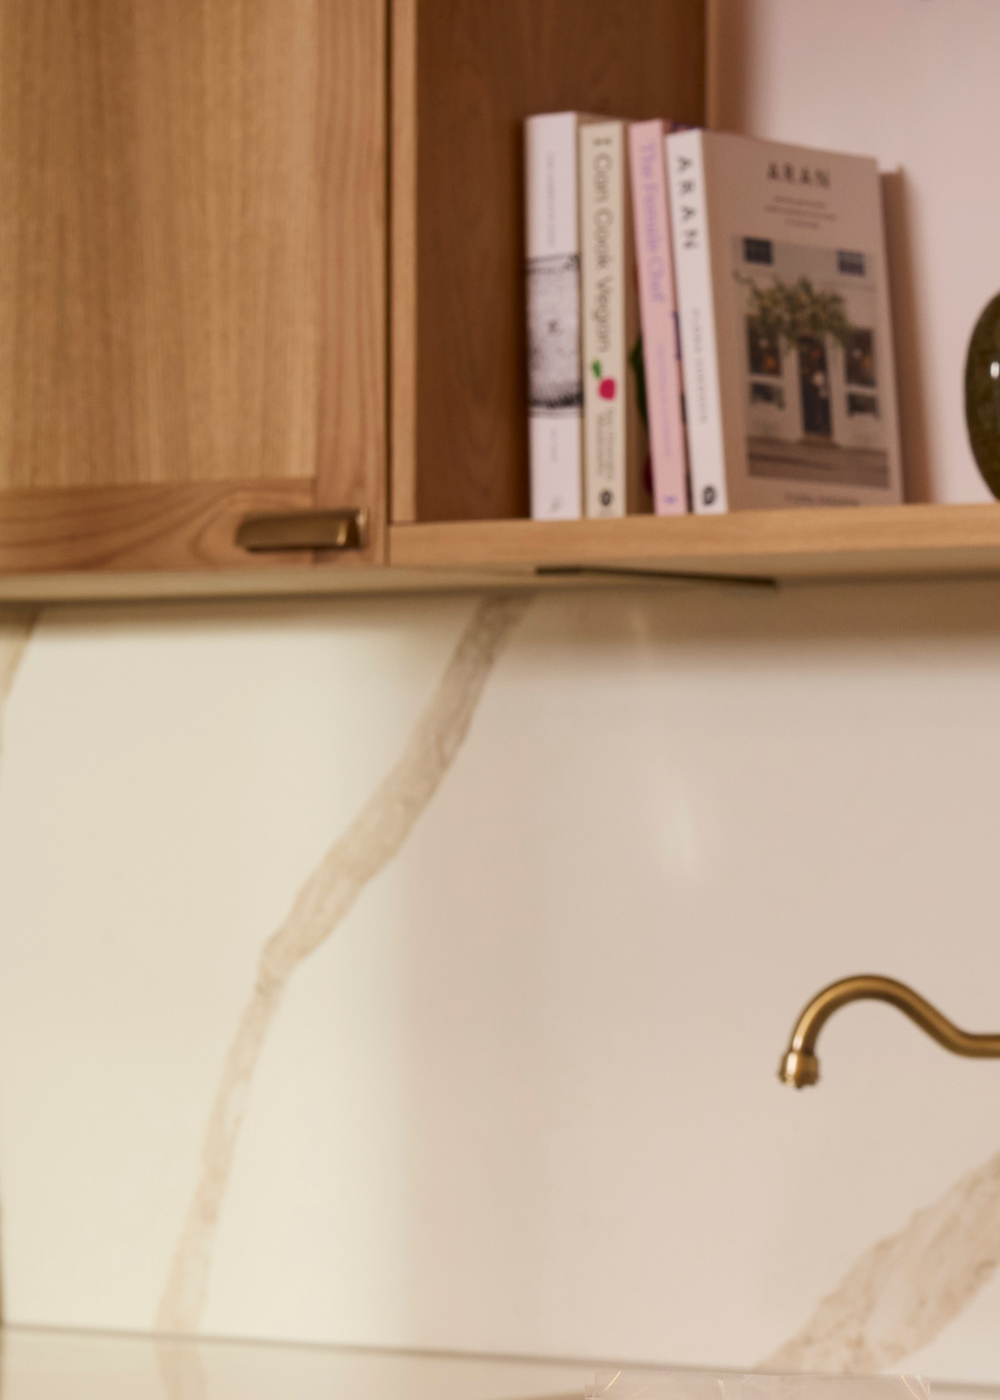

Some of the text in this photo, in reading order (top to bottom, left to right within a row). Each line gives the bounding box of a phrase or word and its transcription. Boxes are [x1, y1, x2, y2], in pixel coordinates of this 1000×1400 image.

[592, 154, 614, 204] Can
[676, 156, 699, 251] ARAN
[766, 161, 831, 189] ARAN
[592, 208, 614, 270] Cook
[639, 141, 666, 305] The Female Chef
[589, 277, 614, 354] Vegan
